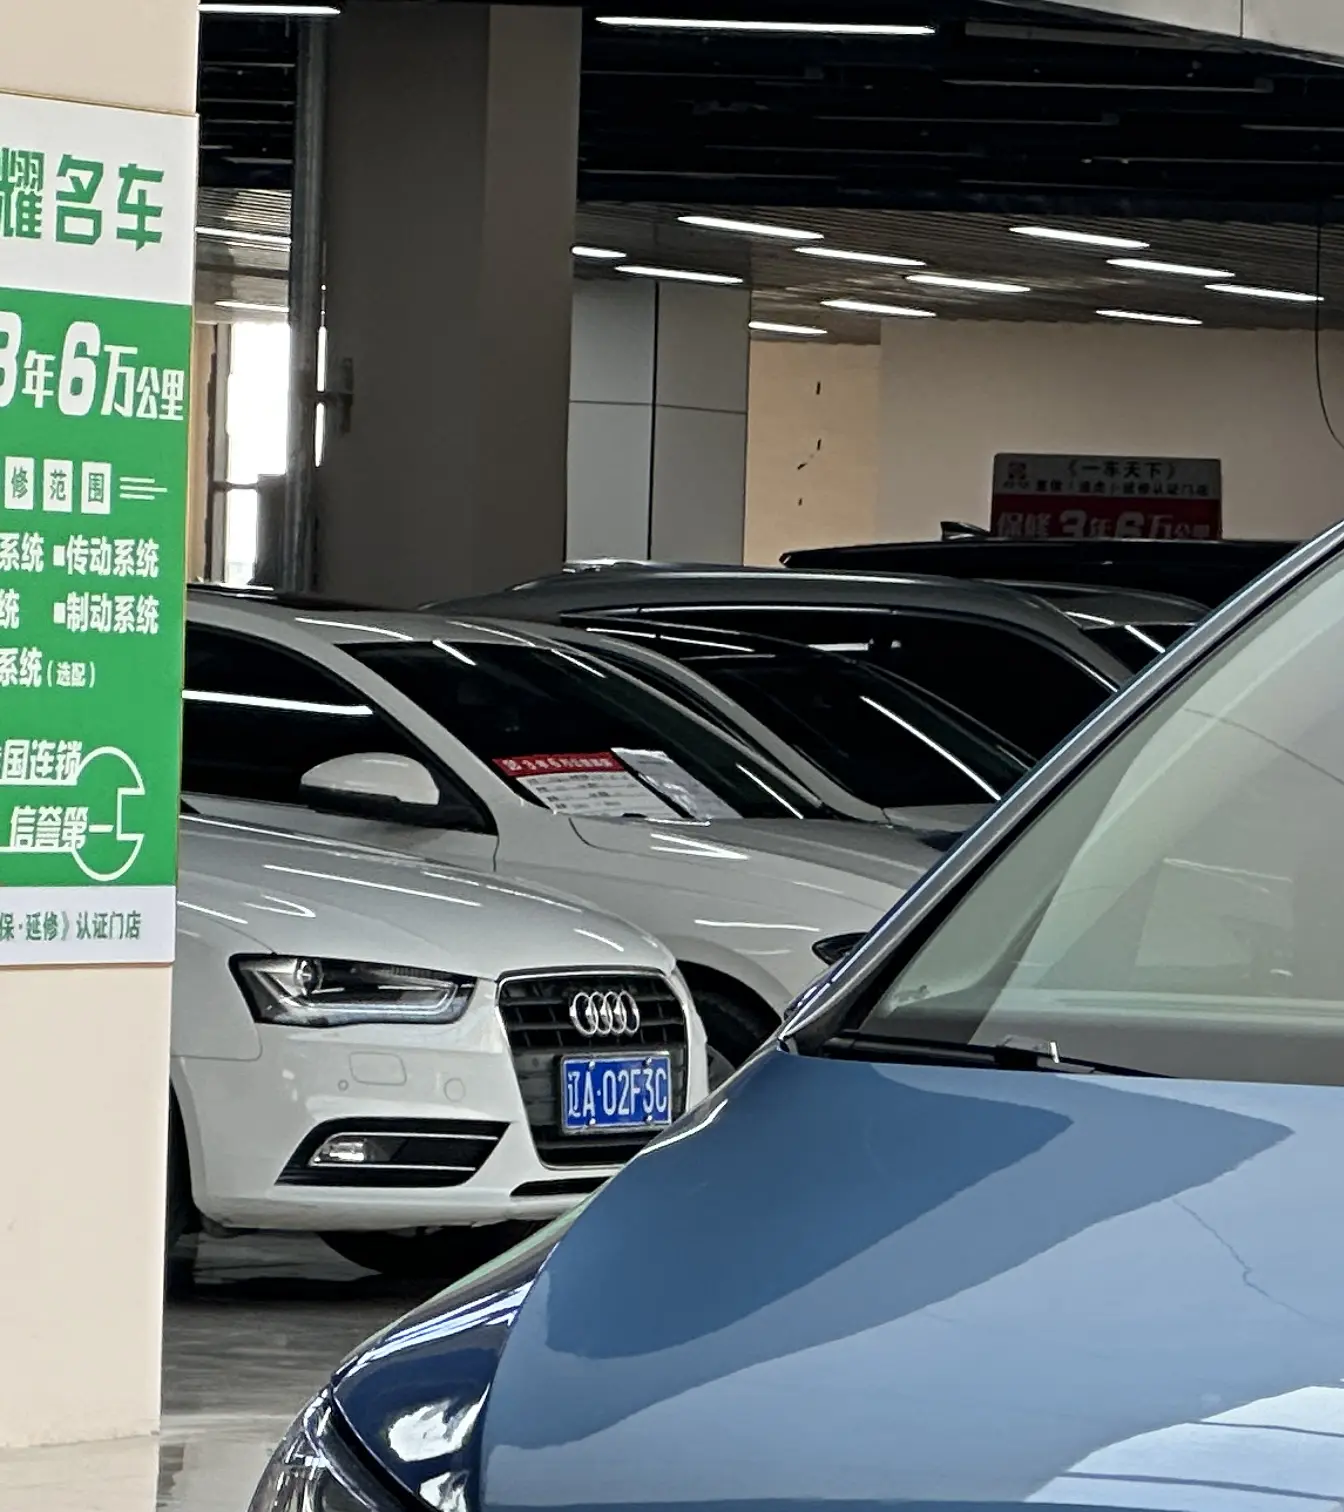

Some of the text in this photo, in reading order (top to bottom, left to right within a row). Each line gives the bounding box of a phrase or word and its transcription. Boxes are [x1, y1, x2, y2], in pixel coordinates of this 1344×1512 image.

[66, 534, 159, 578] 传动系统
[66, 591, 159, 634] 制动系统
[10, 804, 114, 851] 信誉第一
